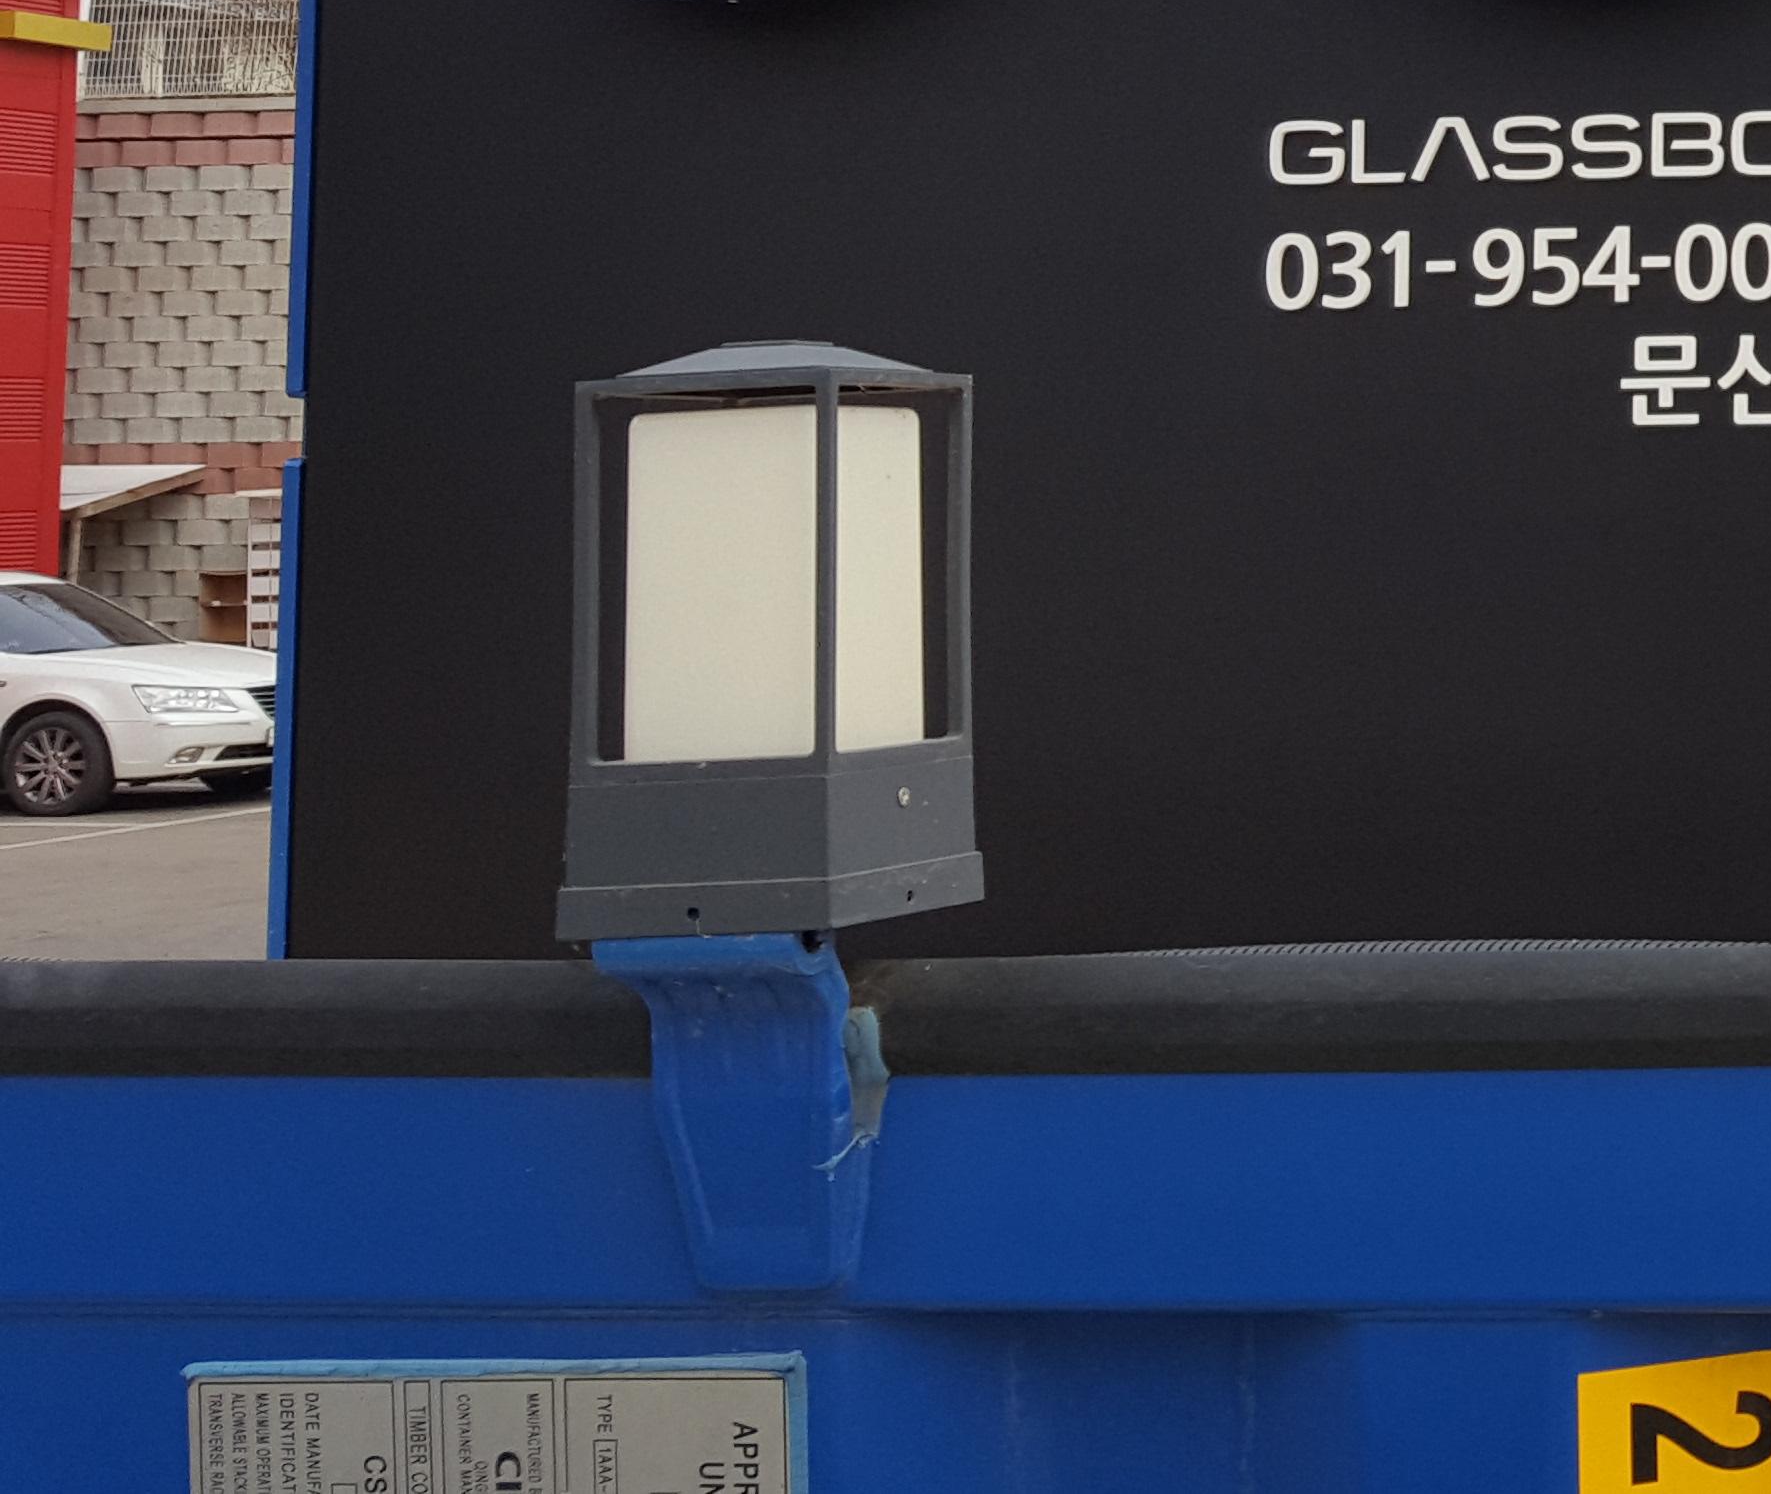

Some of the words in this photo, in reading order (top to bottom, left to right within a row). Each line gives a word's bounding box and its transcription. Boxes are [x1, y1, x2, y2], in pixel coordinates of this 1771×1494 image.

[208, 1393, 224, 1468] TRANSVERSE
[230, 1393, 247, 1453] ALLOWABLE
[255, 1393, 271, 1444] MAXIMUM
[304, 1392, 320, 1431] DATE
[409, 1406, 427, 1465] TIMBER
[457, 1394, 472, 1465] CONTAINER
[526, 1393, 542, 1483] MANUFACTURED
[597, 1395, 612, 1433] TYPE
